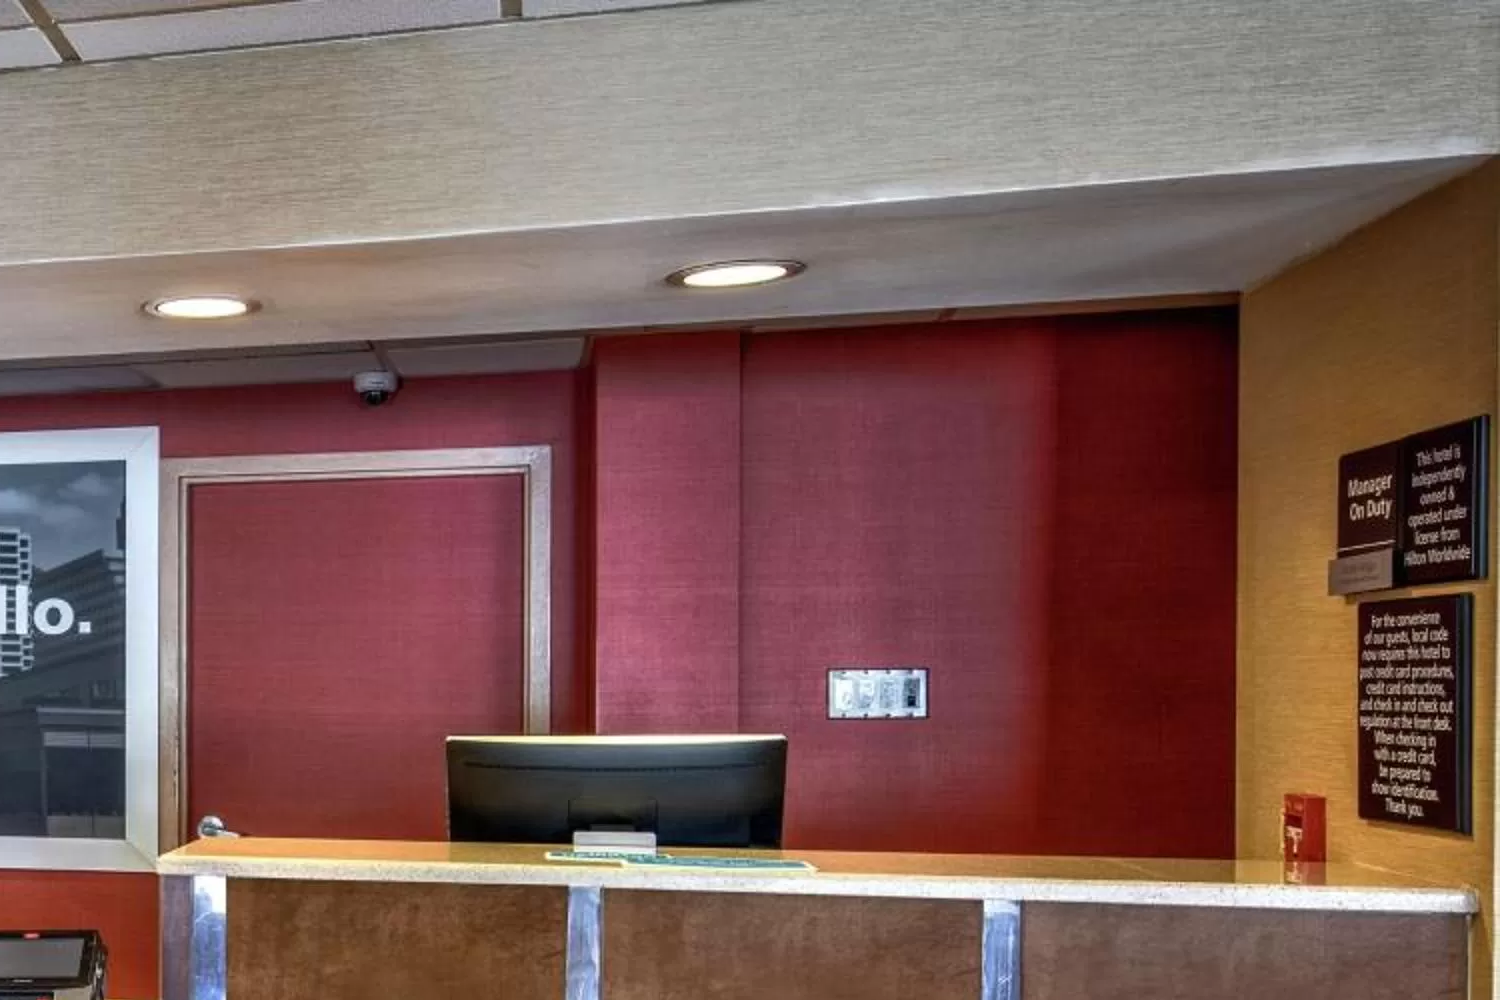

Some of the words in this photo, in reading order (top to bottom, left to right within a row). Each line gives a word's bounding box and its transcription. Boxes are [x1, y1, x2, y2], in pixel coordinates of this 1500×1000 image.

[1348, 474, 1393, 498] Manager
[1349, 502, 1364, 521] On
[1366, 498, 1392, 519] Duty
